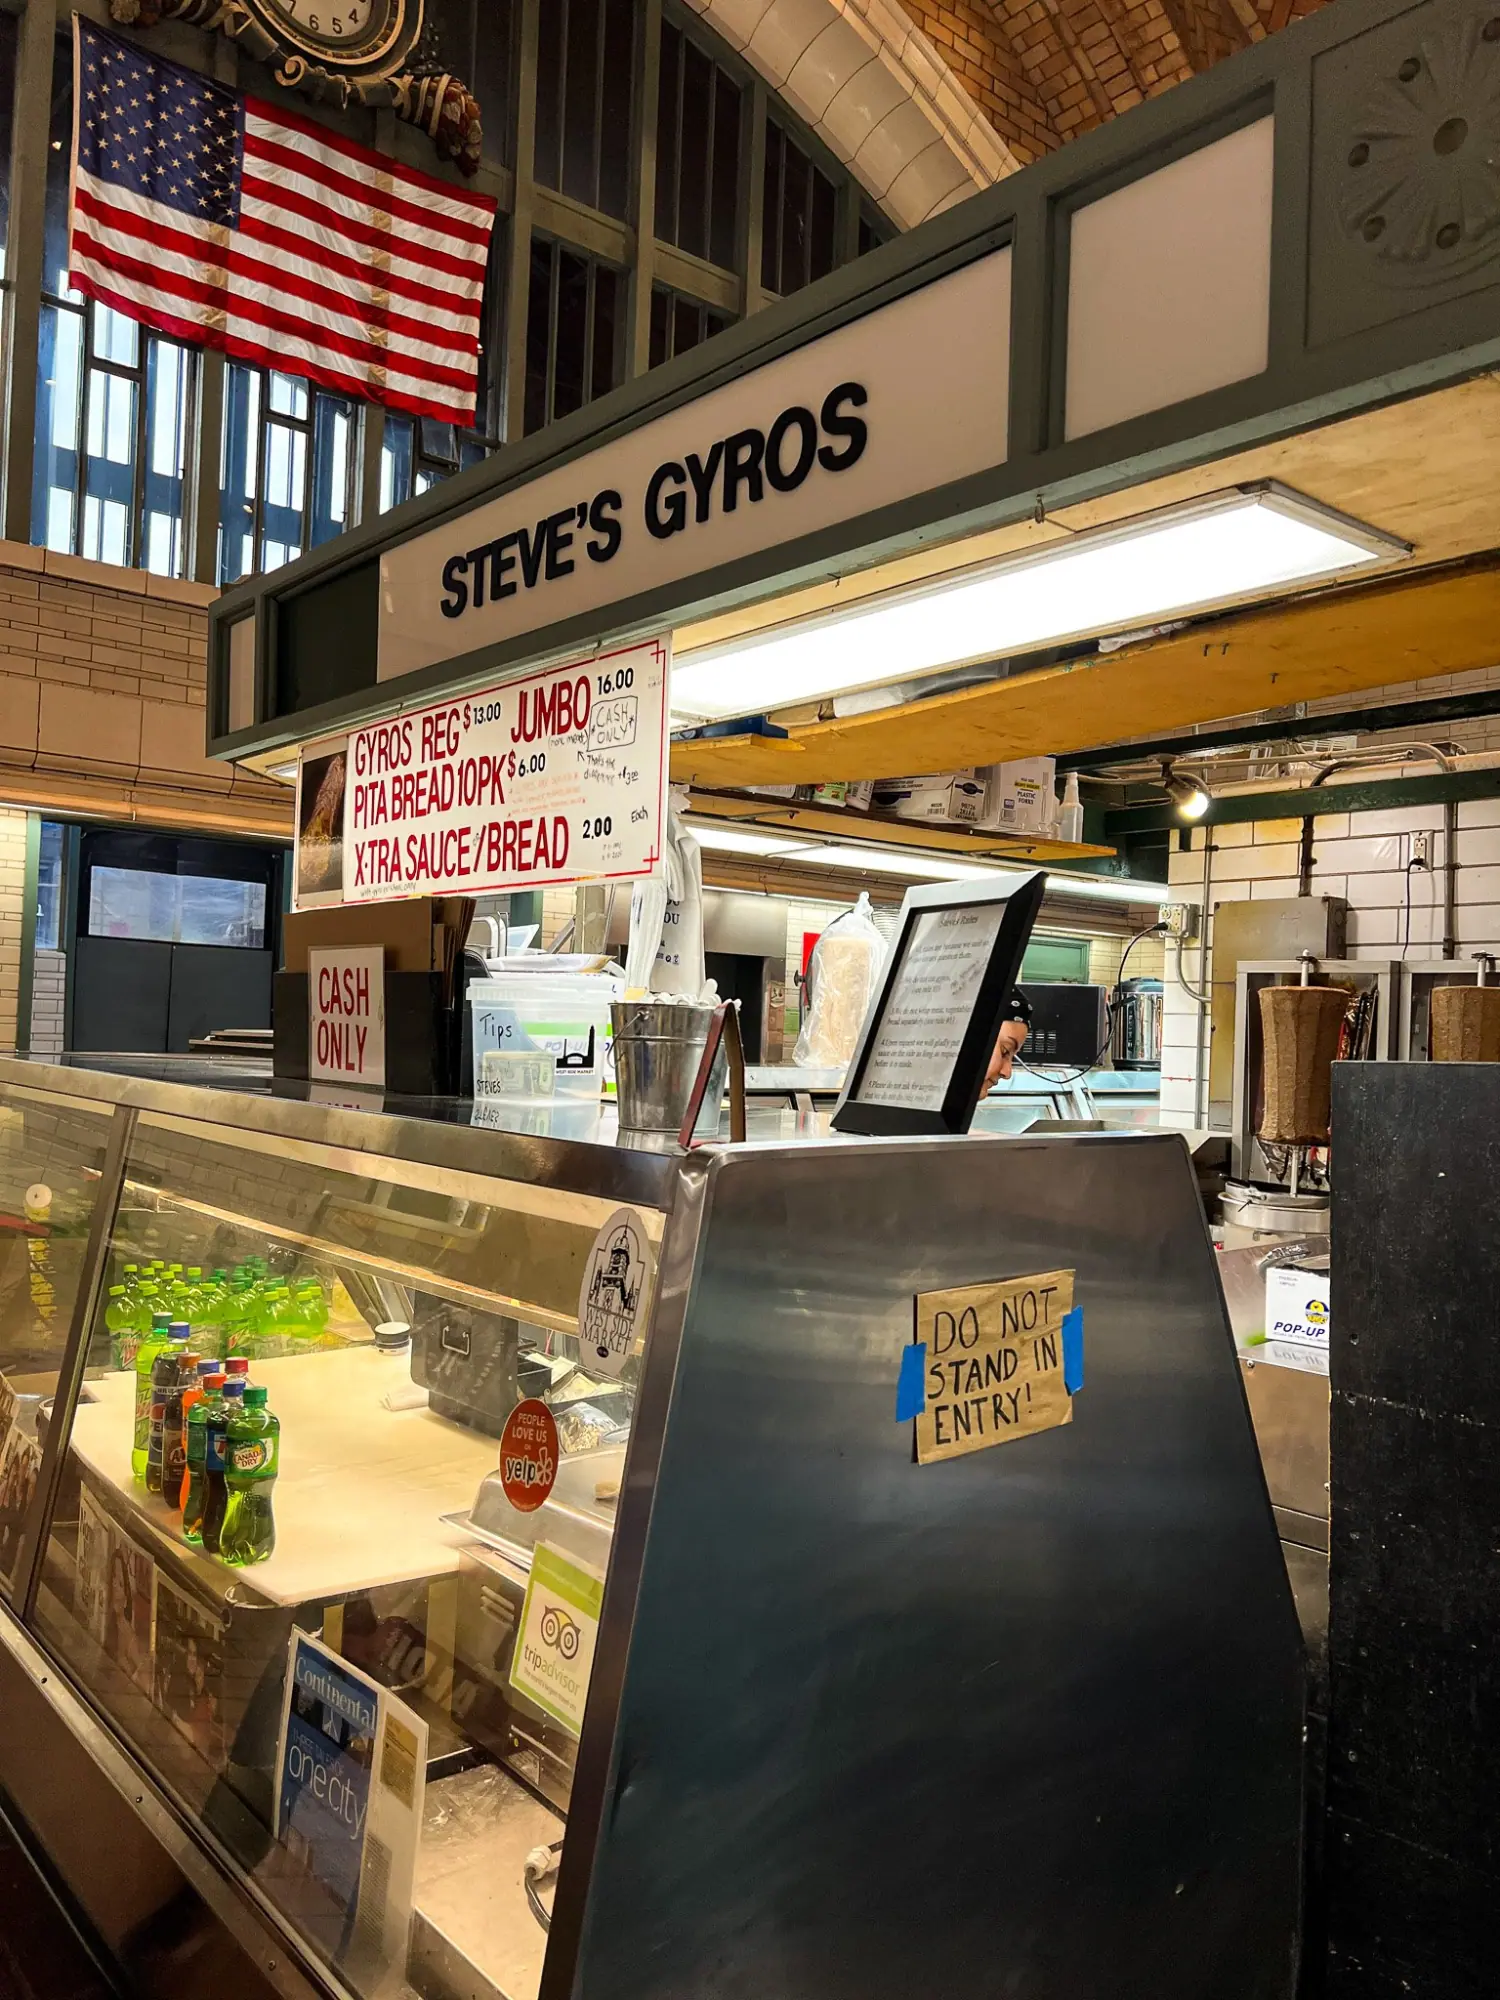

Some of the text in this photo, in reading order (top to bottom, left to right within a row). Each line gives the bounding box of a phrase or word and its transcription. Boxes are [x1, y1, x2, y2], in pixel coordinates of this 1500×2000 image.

[309, 14, 319, 31] 6
[332, 17, 342, 34] 5
[348, 8, 359, 24] 4
[440, 381, 868, 619] STEVE'S GYROS
[597, 667, 634, 695] 16.00
[511, 675, 591, 743] JUMBO
[596, 702, 628, 727] CASH
[354, 720, 413, 776] GYROS
[421, 708, 461, 763] REG
[597, 724, 627, 744] ONLY
[354, 780, 388, 829] PITA
[391, 766, 454, 821] BREAD
[457, 754, 508, 807] 10PK
[1017, 791, 1036, 799] PLASTIC
[583, 816, 612, 840] 2.00
[630, 806, 649, 823] Each
[663, 912, 680, 925] OU
[318, 966, 369, 1016] CASH
[317, 1020, 367, 1074] ONLY
[480, 1013, 512, 1049] Tips
[476, 1079, 501, 1095] STEVE'S
[586, 1307, 634, 1340] WEST SIDE
[934, 1286, 1058, 1355] DO NOT
[1274, 1322, 1325, 1338] POP-UP
[581, 1321, 631, 1355] MARKET
[927, 1333, 1058, 1400] STAND IN
[517, 1412, 546, 1427] PEOPLE
[934, 1382, 1032, 1445] ENTRY!
[512, 1425, 547, 1444] LOVE US
[241, 1458, 258, 1468] DRY
[506, 1456, 536, 1488] yelp
[524, 1643, 581, 1697] tripadvisor
[296, 1656, 377, 1732] Continental
[289, 1745, 327, 1798] one
[328, 1777, 367, 1840] city
